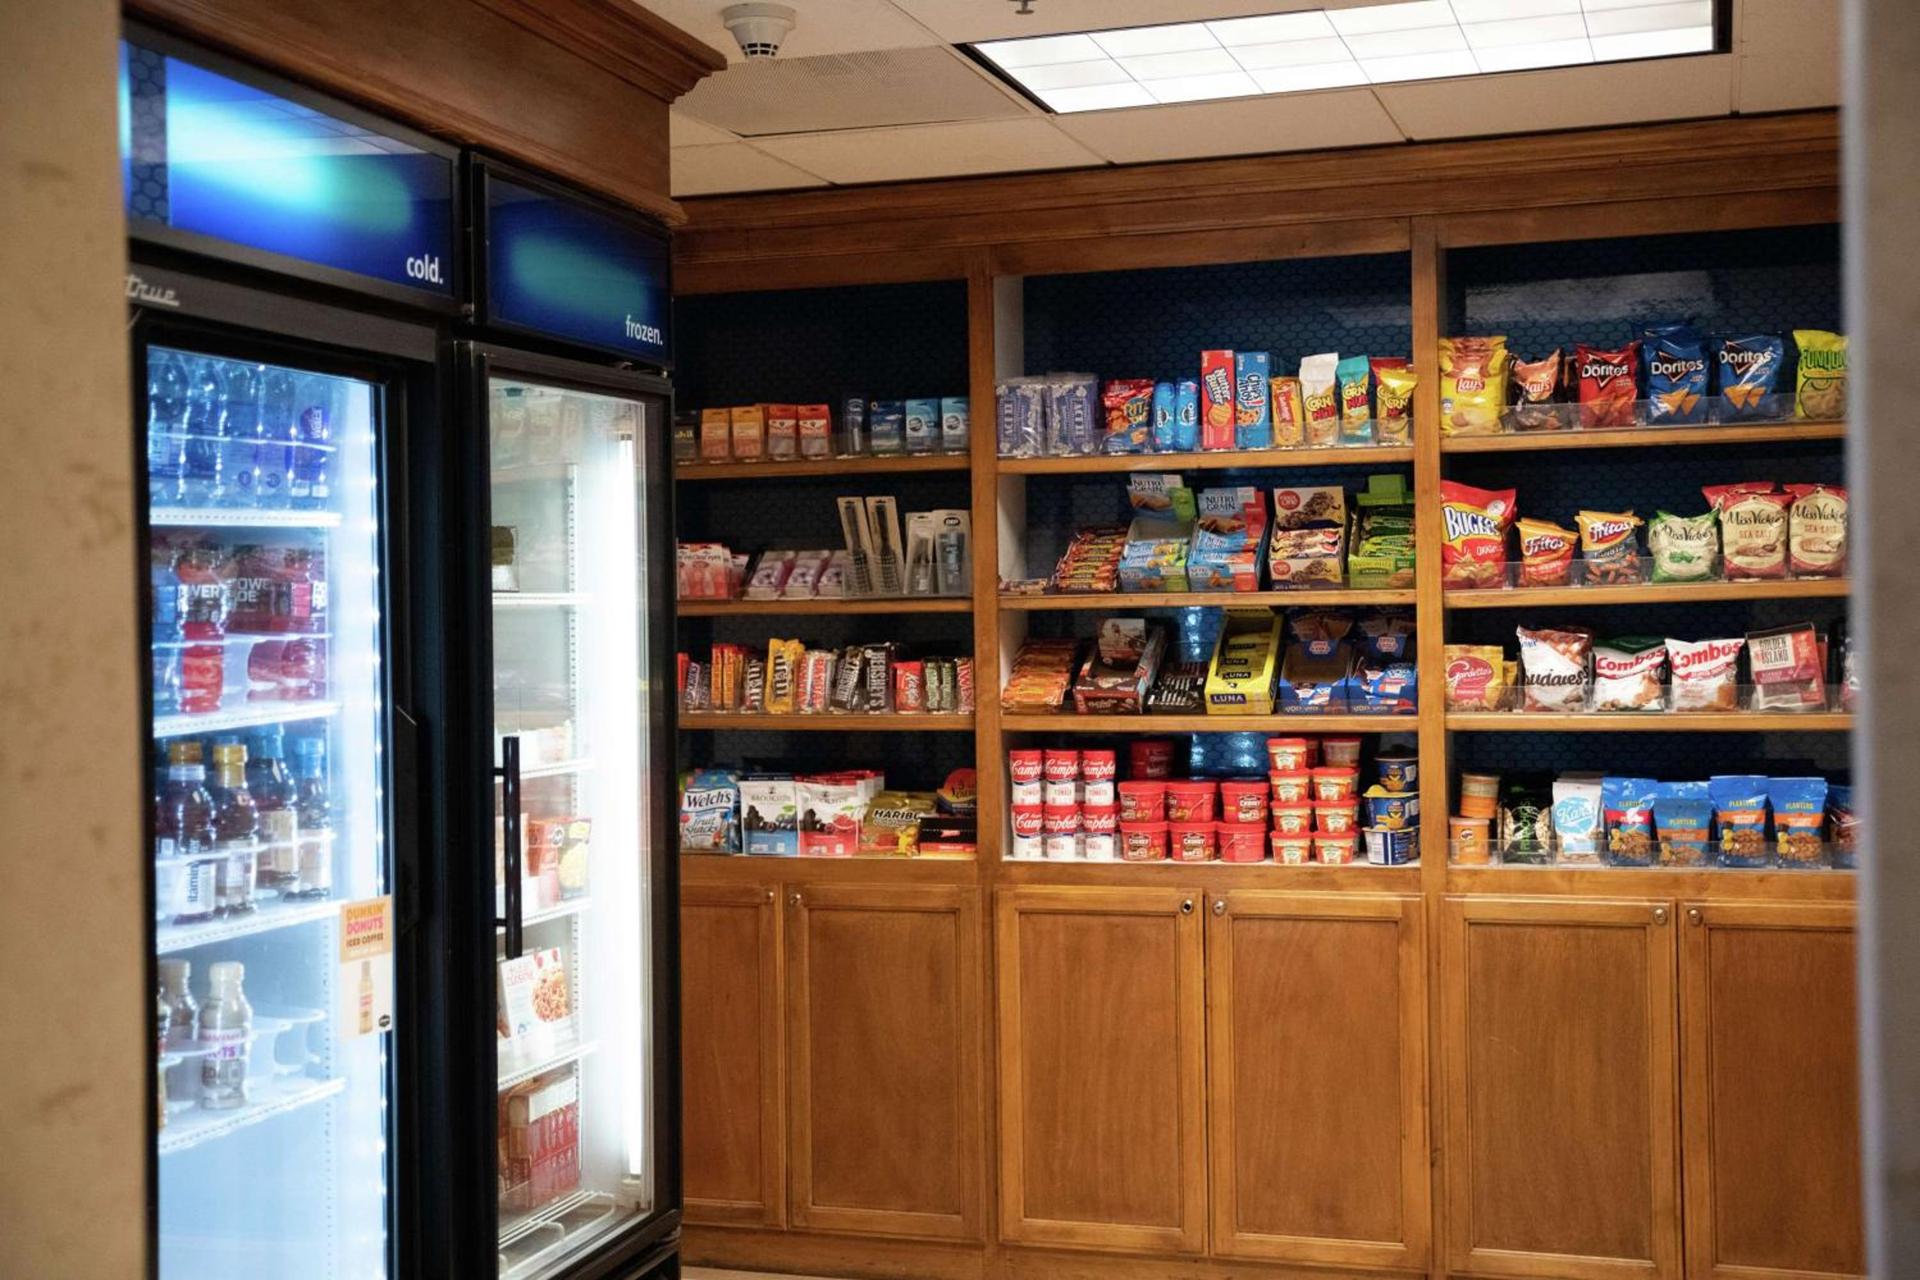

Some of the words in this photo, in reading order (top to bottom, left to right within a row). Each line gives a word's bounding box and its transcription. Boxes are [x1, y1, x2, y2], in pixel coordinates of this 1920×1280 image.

[406, 254, 444, 286] cold.
[625, 314, 663, 346] frozen.
[1719, 350, 1773, 364] Doritos
[1582, 363, 1629, 379] Doritos
[1651, 358, 1705, 376] Doritos
[1457, 376, 1486, 393] Lay's
[1205, 495, 1236, 505] NUTRI
[1206, 503, 1237, 512] GRAIN
[1726, 510, 1751, 526] Miss
[1792, 504, 1817, 519] Miss
[1588, 520, 1634, 542] Fritos
[1523, 534, 1565, 556] Fritos
[1671, 640, 1743, 669] Combos
[1760, 647, 1789, 665] ISLAND
[1212, 694, 1245, 703] LUNA
[687, 790, 732, 808] Welch's
[346, 903, 385, 921] DUNKIN'
[346, 918, 384, 935] DONUTS
